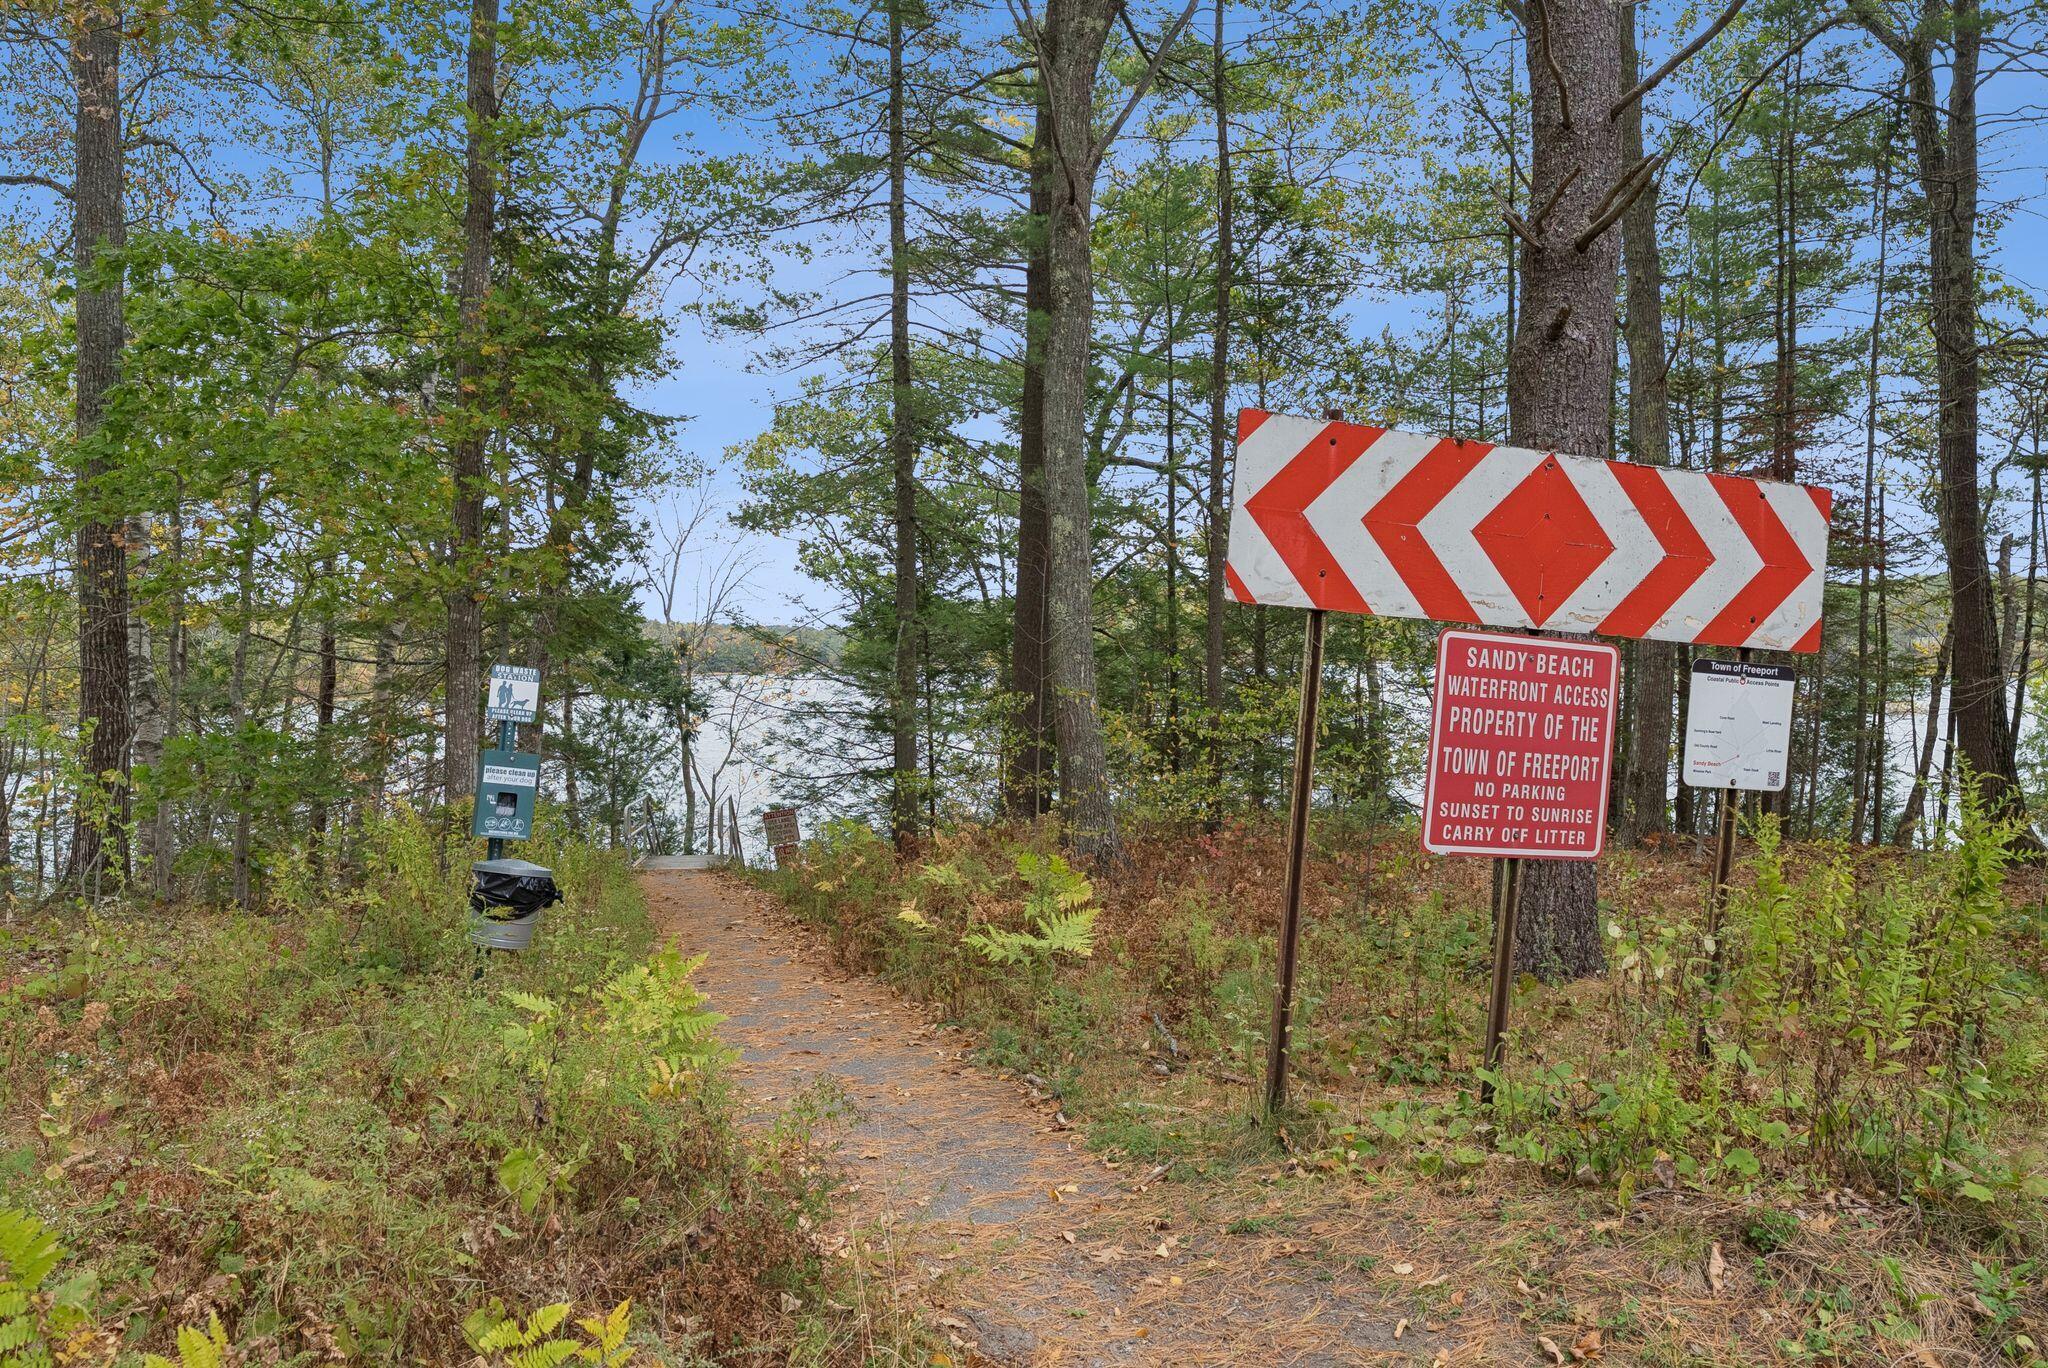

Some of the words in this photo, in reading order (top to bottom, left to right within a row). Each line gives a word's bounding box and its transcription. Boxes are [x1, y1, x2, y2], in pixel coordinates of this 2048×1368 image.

[513, 666, 536, 676] WASTE
[1466, 646, 1528, 672] SANDY
[1536, 654, 1594, 678] BEACH
[1711, 662, 1731, 672] Town
[1733, 664, 1742, 672] of
[1742, 666, 1778, 676] Freeport
[498, 672, 534, 682] STATION
[1448, 674, 1548, 702] WATERFRONT
[1554, 684, 1608, 708] ACCESS
[1450, 706, 1538, 738] PROPERTY
[1544, 714, 1564, 740] OF
[1572, 716, 1599, 742] THE
[486, 767, 507, 775] please
[1443, 746, 1490, 775] TOWN
[1496, 750, 1517, 776] OF
[1523, 752, 1600, 781] FREEPORT
[1474, 782, 1495, 797] NO
[1502, 784, 1566, 800] PARKING
[1440, 802, 1499, 820] SUNSET
[1507, 806, 1524, 820] TO
[1532, 807, 1592, 824] SUNRISE
[1442, 824, 1494, 842] CARRY
[1502, 828, 1528, 843] OFF
[1536, 829, 1586, 845] LITTER
